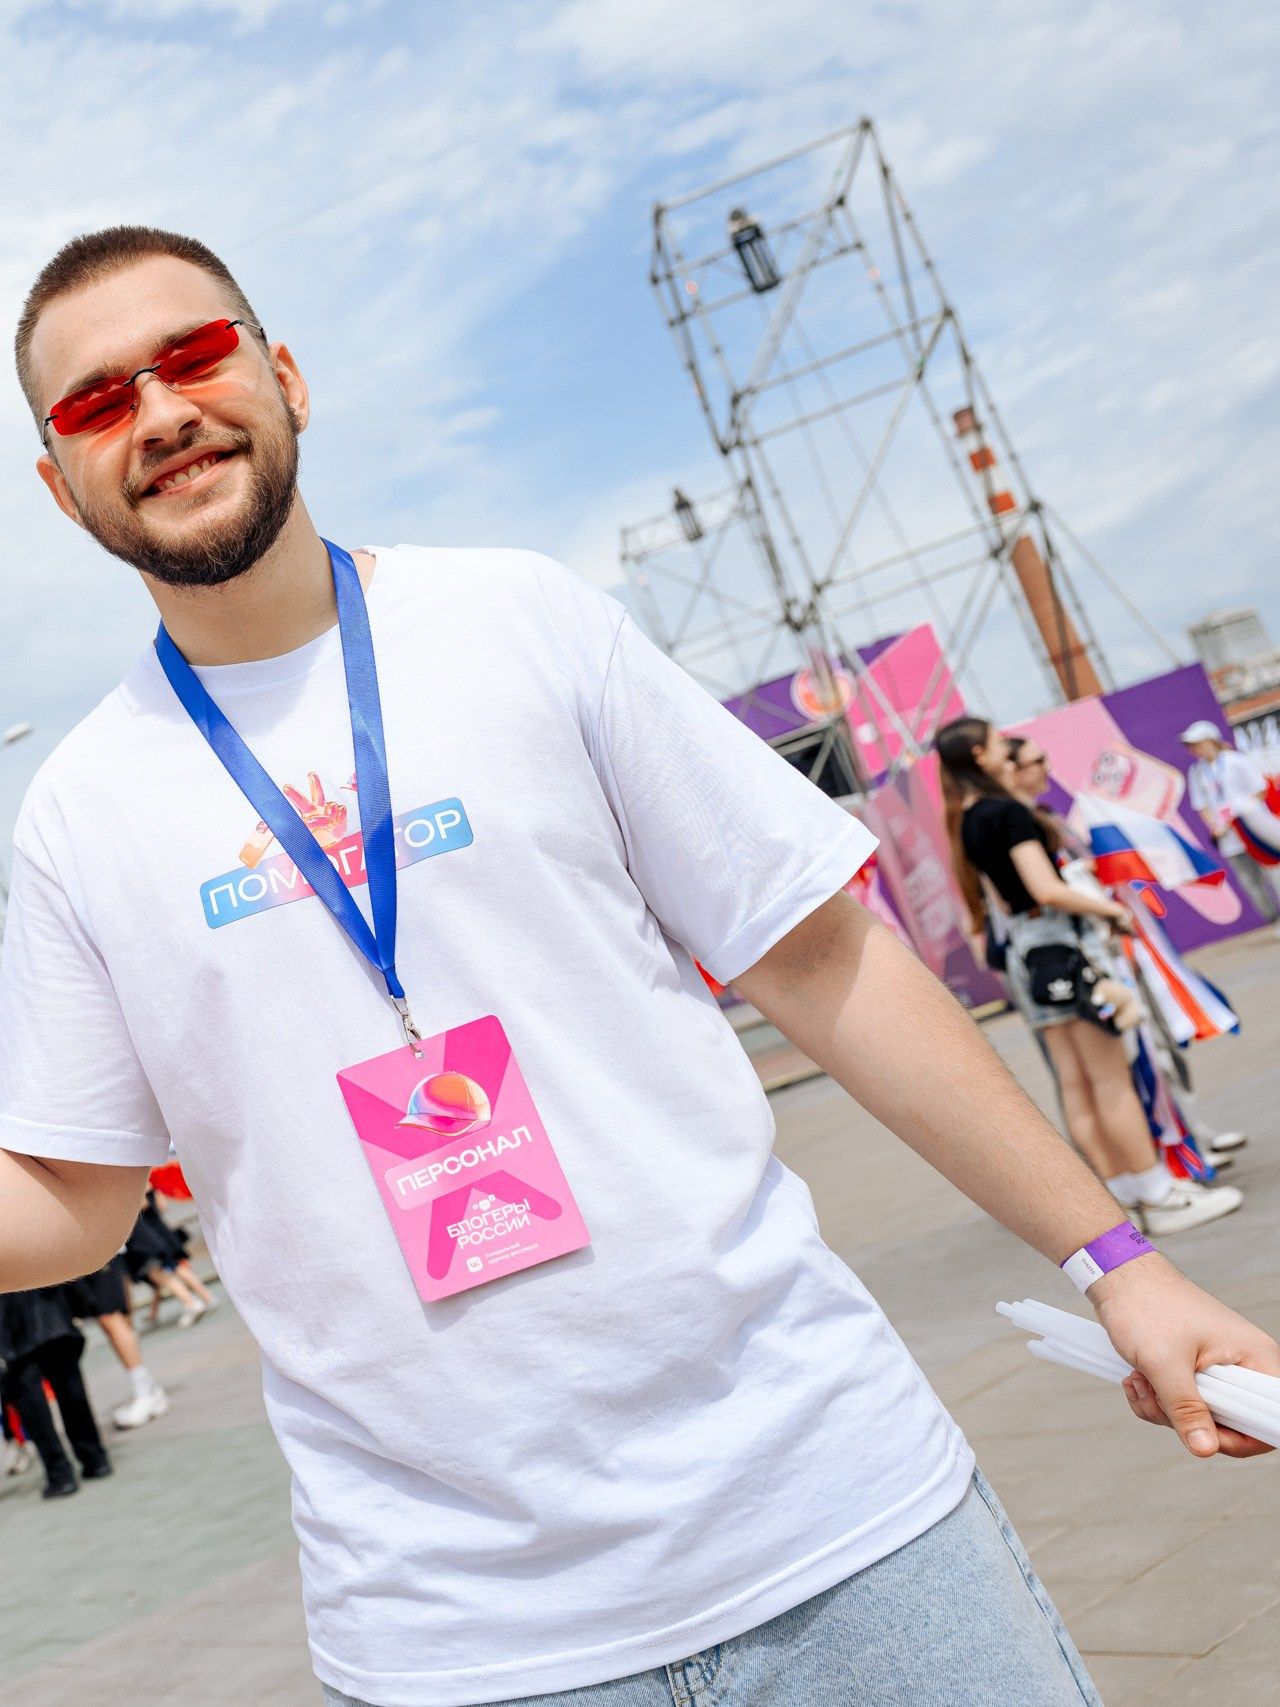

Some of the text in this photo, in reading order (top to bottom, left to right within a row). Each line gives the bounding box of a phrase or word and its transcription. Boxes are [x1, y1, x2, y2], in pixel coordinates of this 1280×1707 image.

[208, 809, 461, 915] ПОМГОР
[396, 1125, 533, 1196] ПЕРСОНАЛ
[446, 1198, 531, 1239] БЛОГЕРЫ
[457, 1213, 531, 1250] РОССИИ
